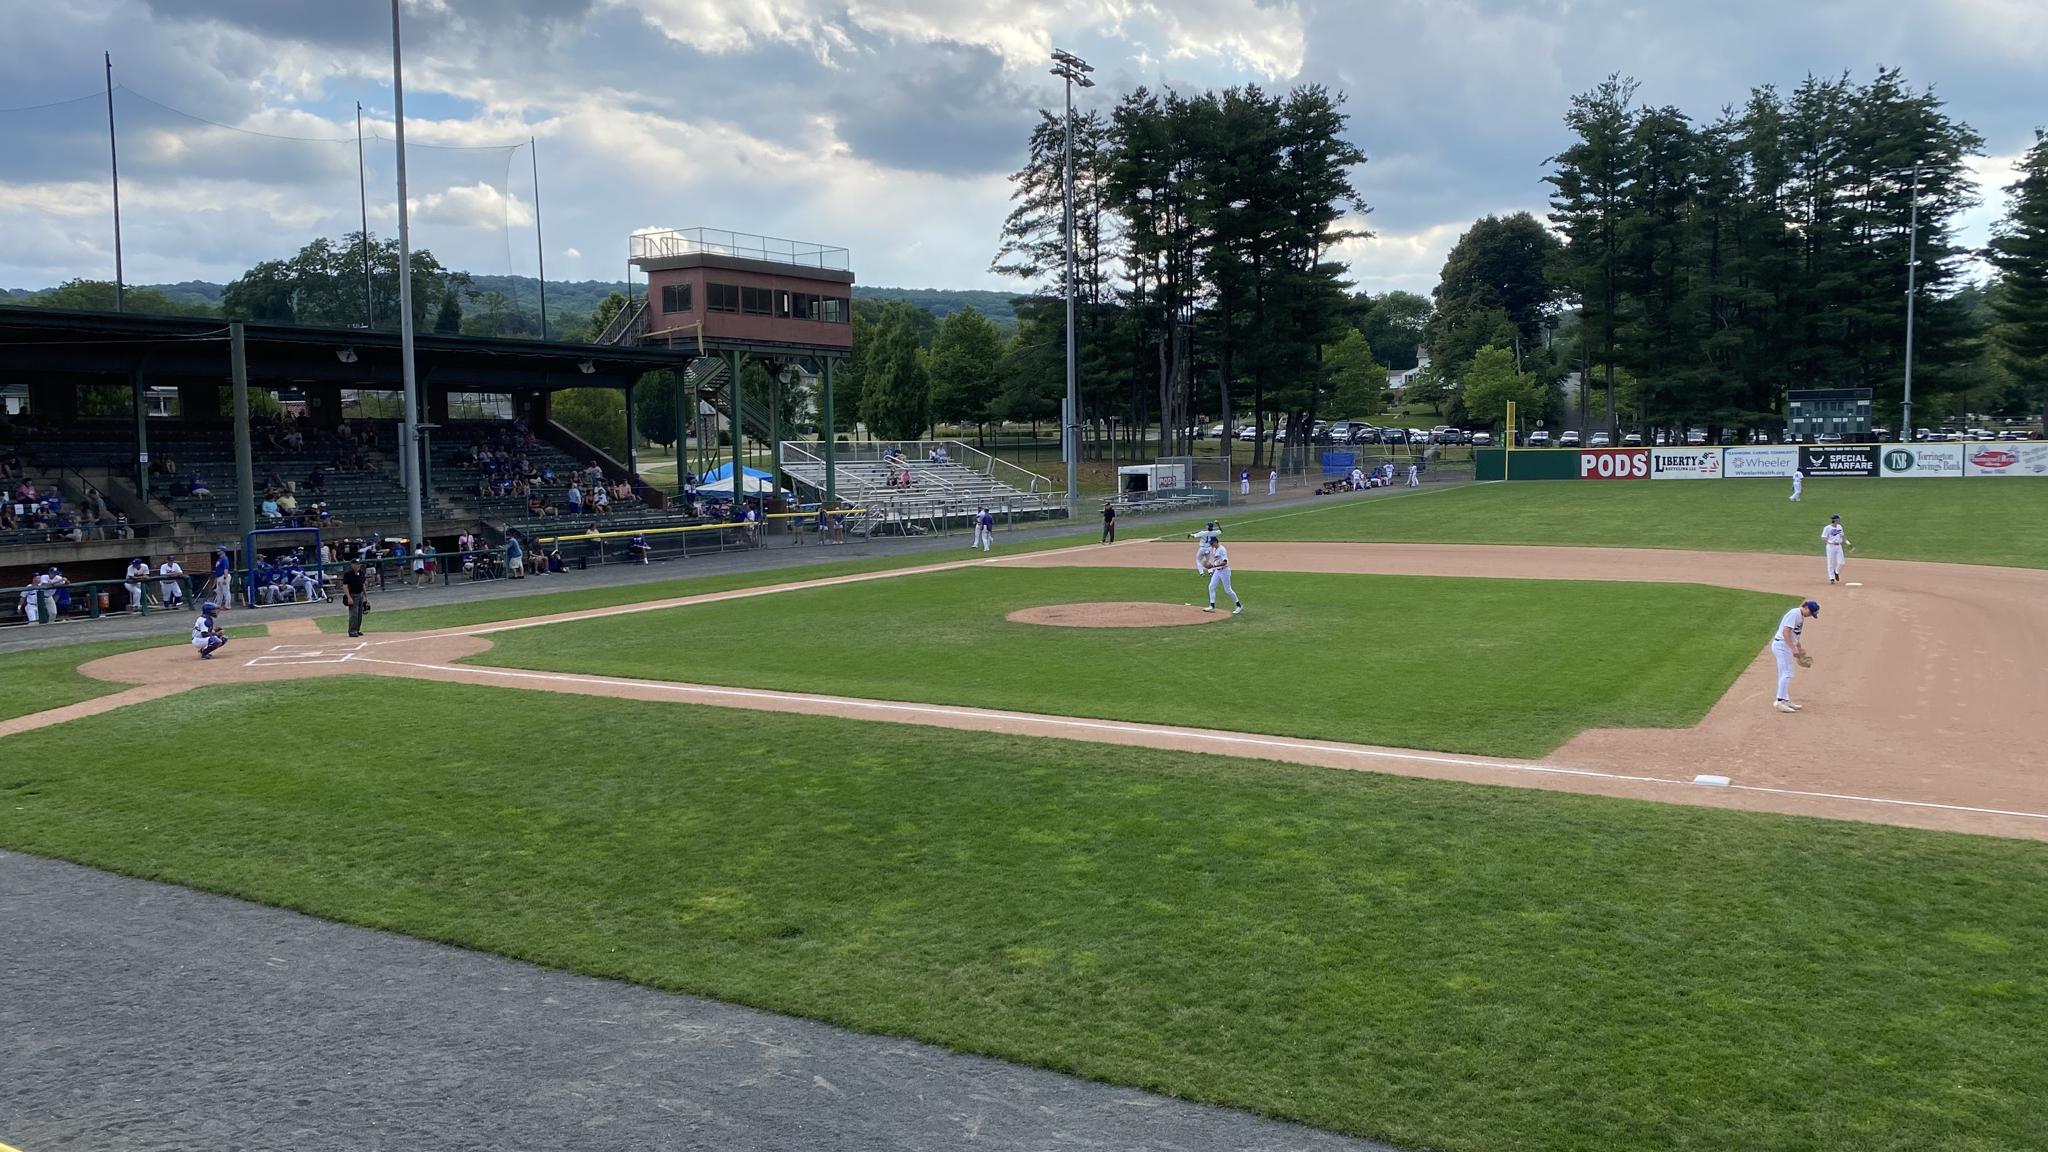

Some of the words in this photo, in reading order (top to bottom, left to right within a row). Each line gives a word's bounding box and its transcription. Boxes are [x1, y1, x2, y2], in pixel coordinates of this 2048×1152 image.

[1746, 457, 1791, 467] Wheeler
[1891, 453, 1907, 469] TSB
[1917, 451, 1954, 462] Torrington
[1581, 454, 1647, 477] PODS
[1654, 455, 1698, 472] LIBERTY
[1830, 462, 1873, 470] WARFARE
[1916, 462, 1942, 472] Savings
[1943, 461, 1961, 470] Bank
